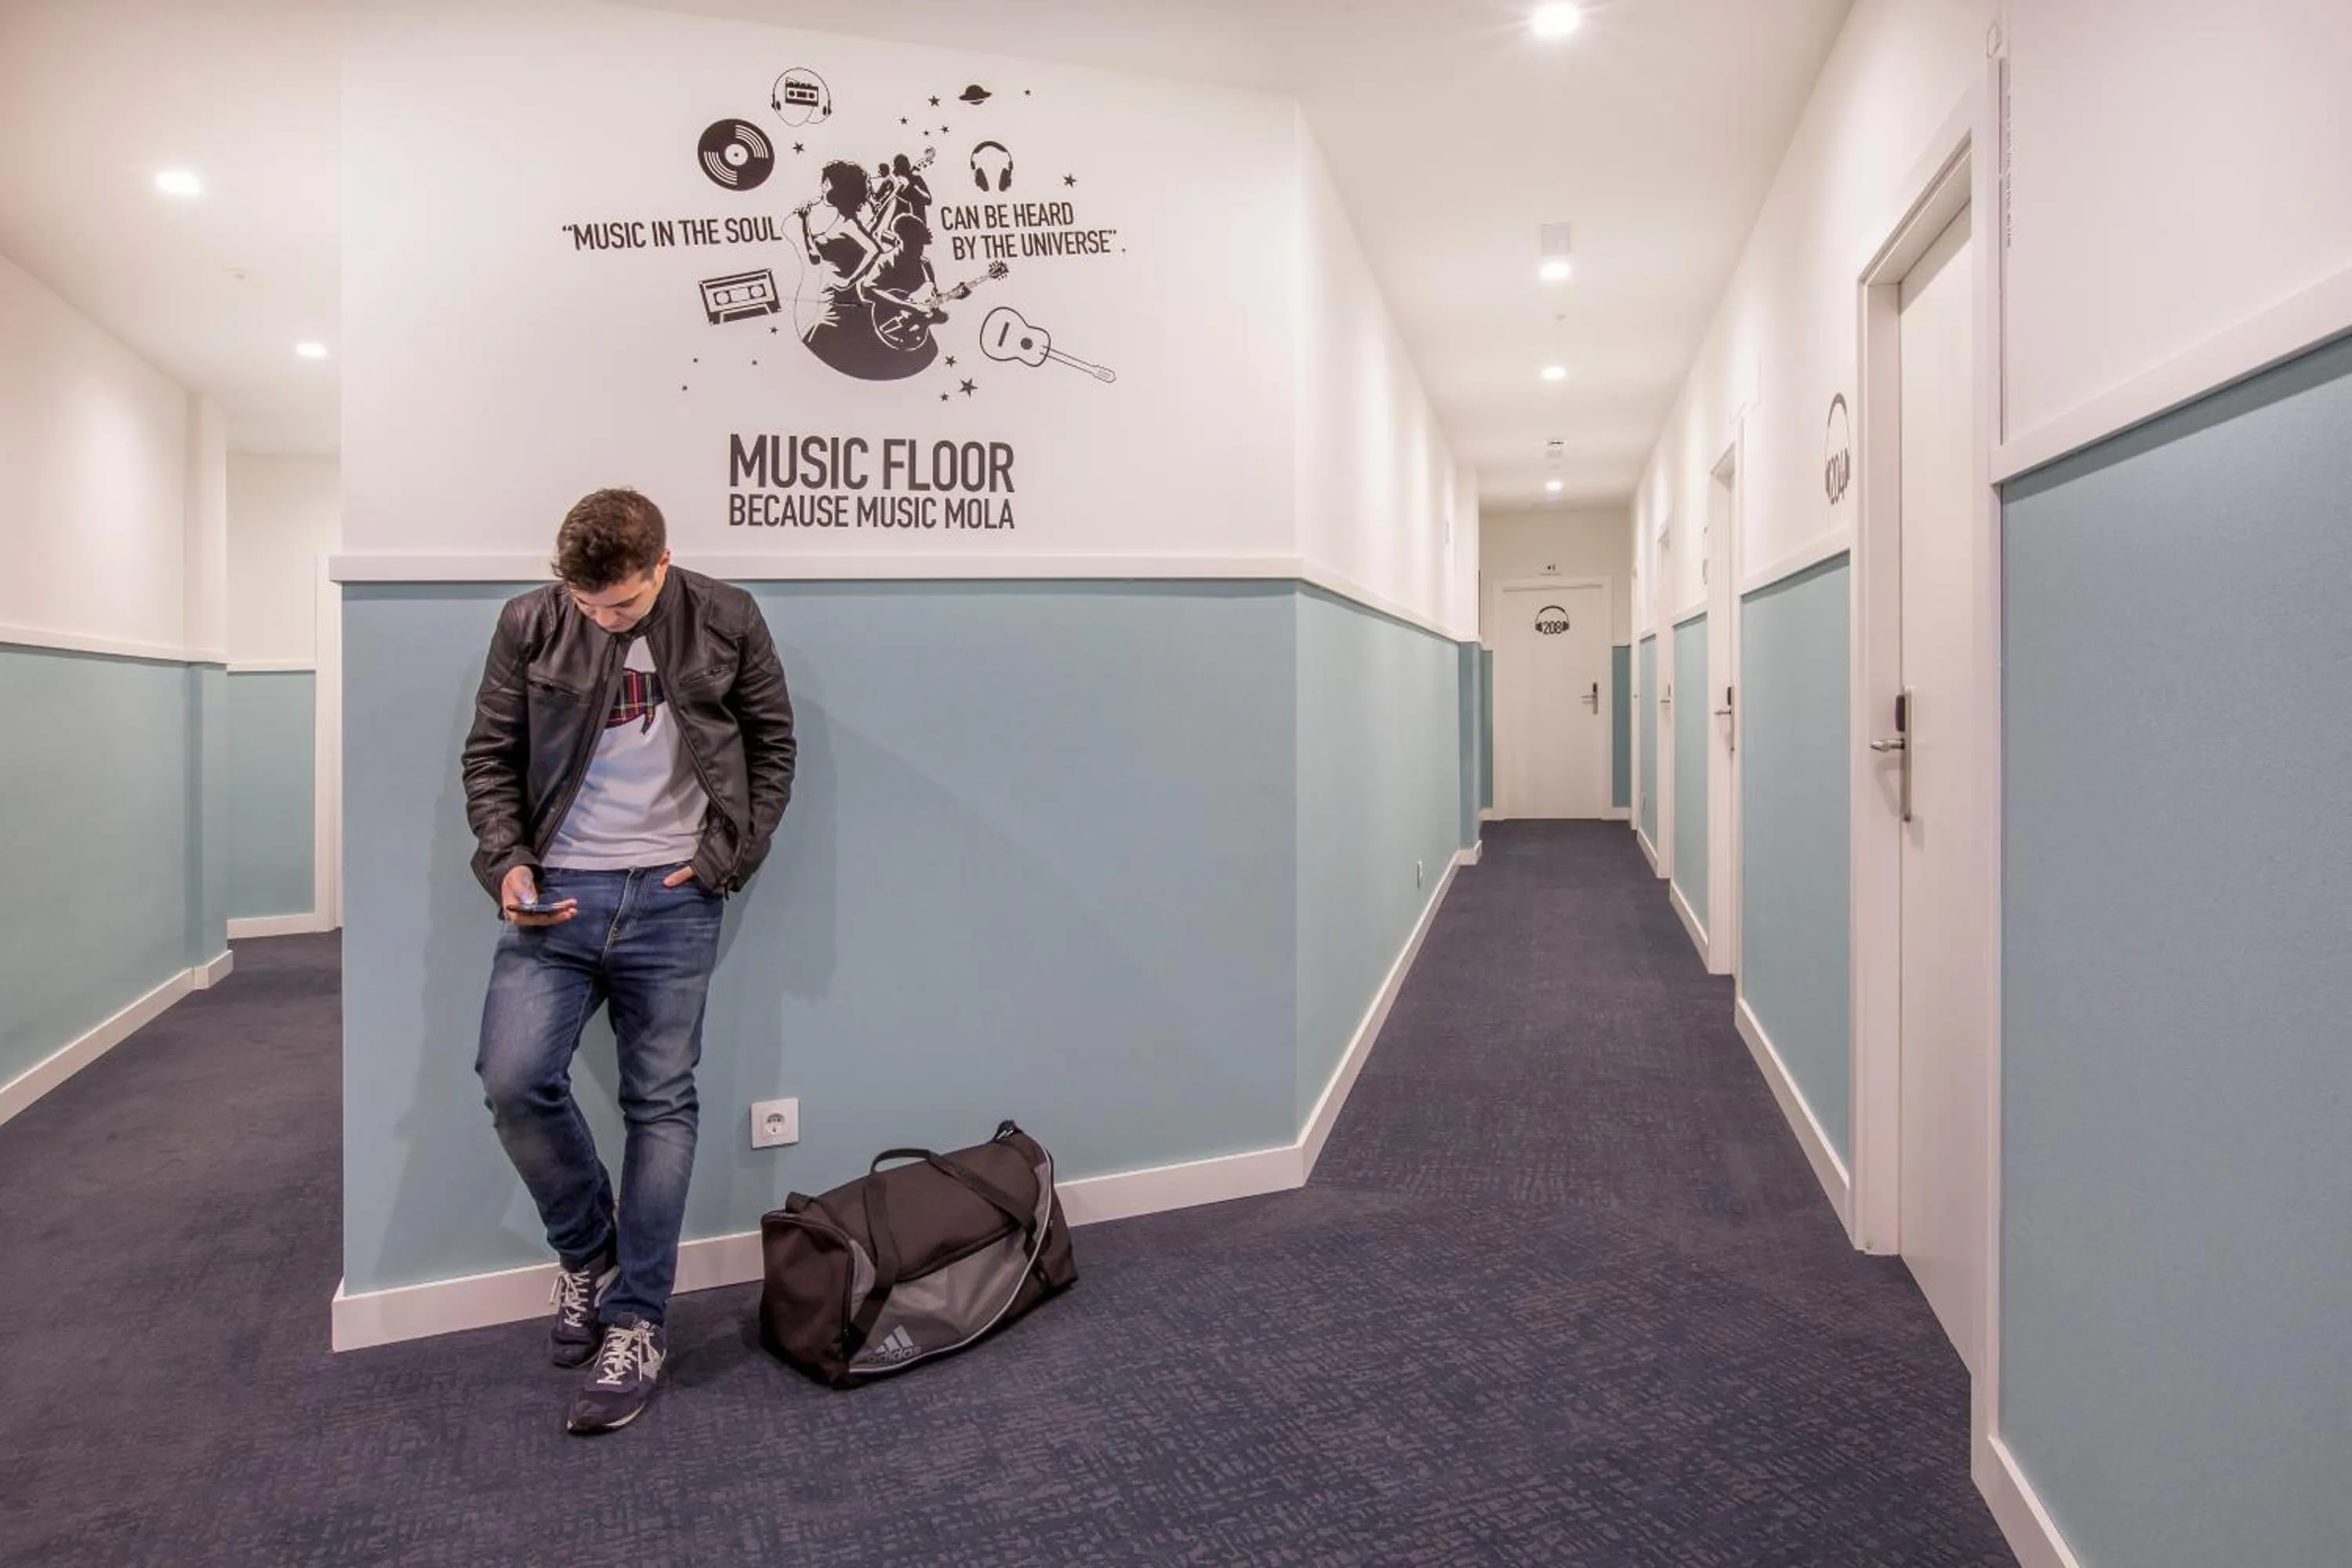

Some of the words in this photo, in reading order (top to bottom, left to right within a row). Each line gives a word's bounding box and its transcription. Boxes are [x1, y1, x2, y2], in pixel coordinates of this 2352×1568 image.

[941, 205, 980, 230] CAN
[984, 204, 1010, 229] BE
[1013, 201, 1074, 228] HEARD
[652, 220, 676, 247] IN
[678, 219, 721, 245] THE
[724, 216, 783, 245] SOUL
[952, 235, 976, 260] BY
[980, 234, 1018, 259] THE
[729, 434, 869, 490] MUSIC
[883, 438, 1015, 493] FLOOR
[729, 493, 849, 528] BECAUSE
[856, 495, 937, 528] MUSIC
[945, 497, 1015, 529] MOLA
[1542, 620, 1563, 634] 208
